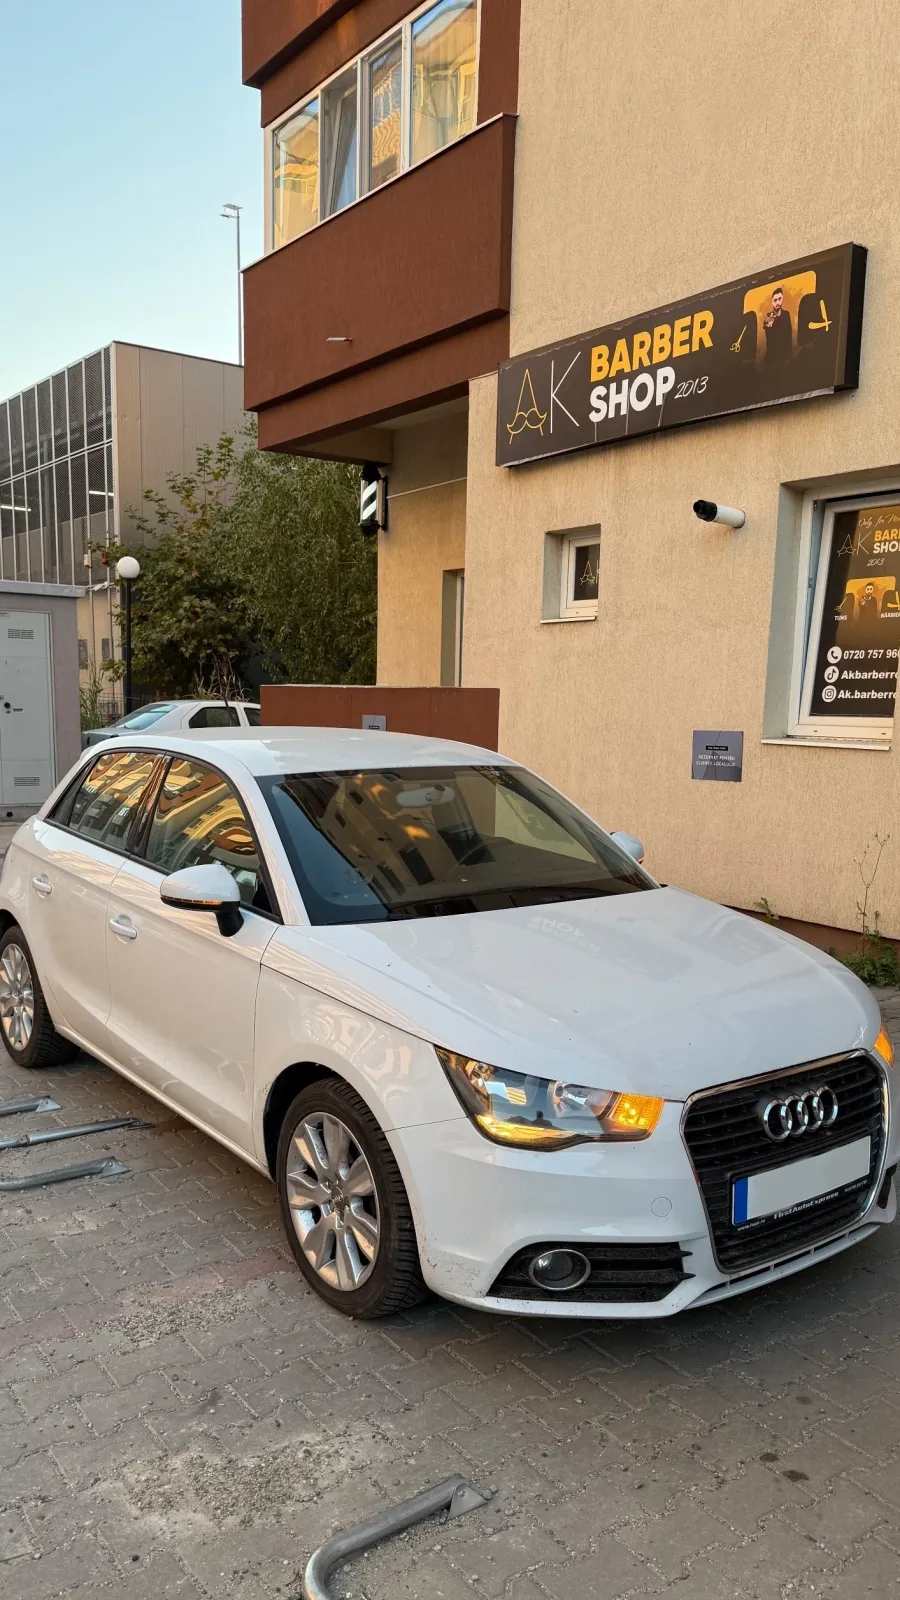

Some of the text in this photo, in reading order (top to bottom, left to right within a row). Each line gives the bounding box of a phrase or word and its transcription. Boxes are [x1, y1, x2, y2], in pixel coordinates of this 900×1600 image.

[590, 310, 714, 383] BARBER
[588, 366, 709, 424] SHOP 2013
[872, 540, 900, 554] SHO
[843, 649, 865, 660] 0720
[867, 649, 884, 659] 757
[773, 1191, 839, 1220] FirstAutoExpress
